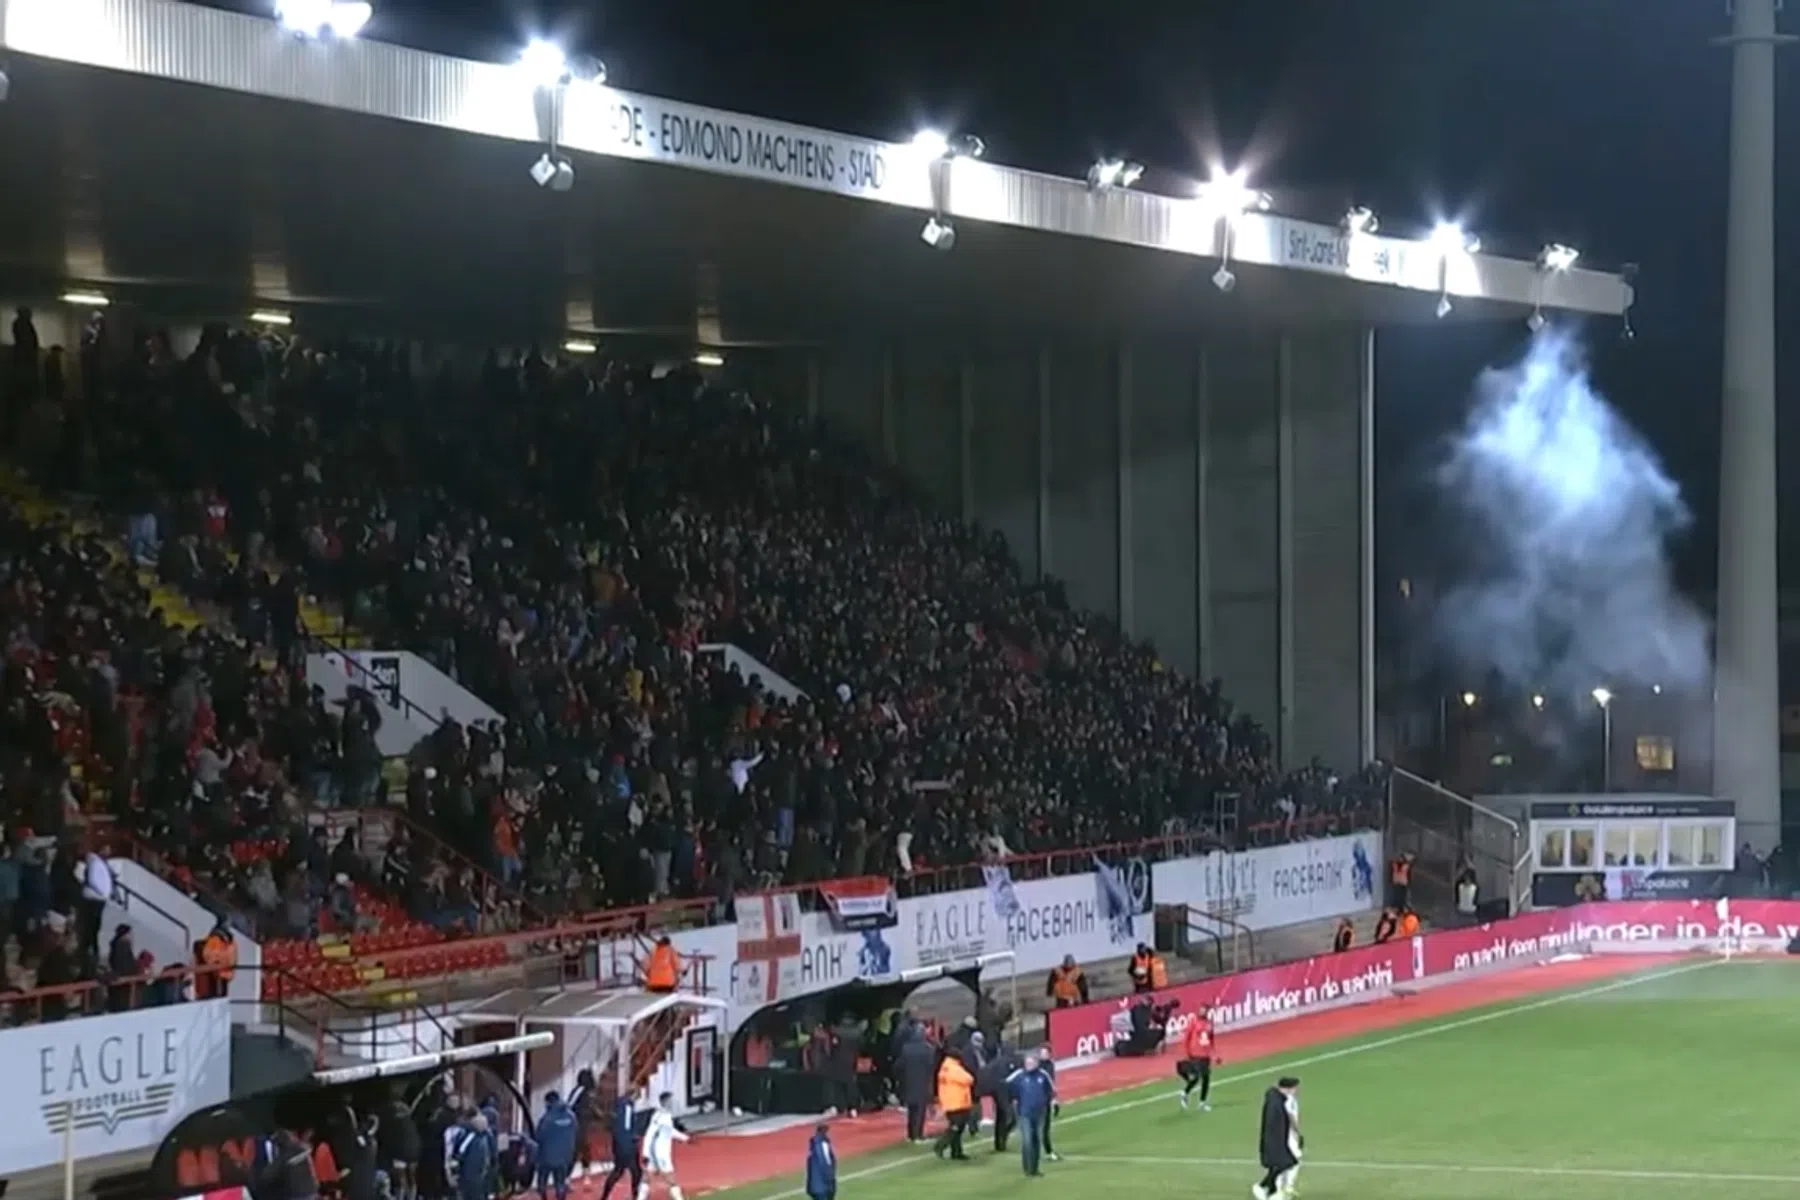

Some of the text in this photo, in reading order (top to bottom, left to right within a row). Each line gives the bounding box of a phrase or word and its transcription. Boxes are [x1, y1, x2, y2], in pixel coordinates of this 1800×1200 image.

[661, 113, 742, 164] EDMOND
[746, 130, 834, 182] MACHTENS
[915, 900, 986, 946] EAGLE
[1006, 899, 1096, 946] FACEBANK
[730, 941, 848, 998] FANK
[39, 1027, 178, 1097] EAGLE
[75, 1089, 142, 1113] FOOTBALL
